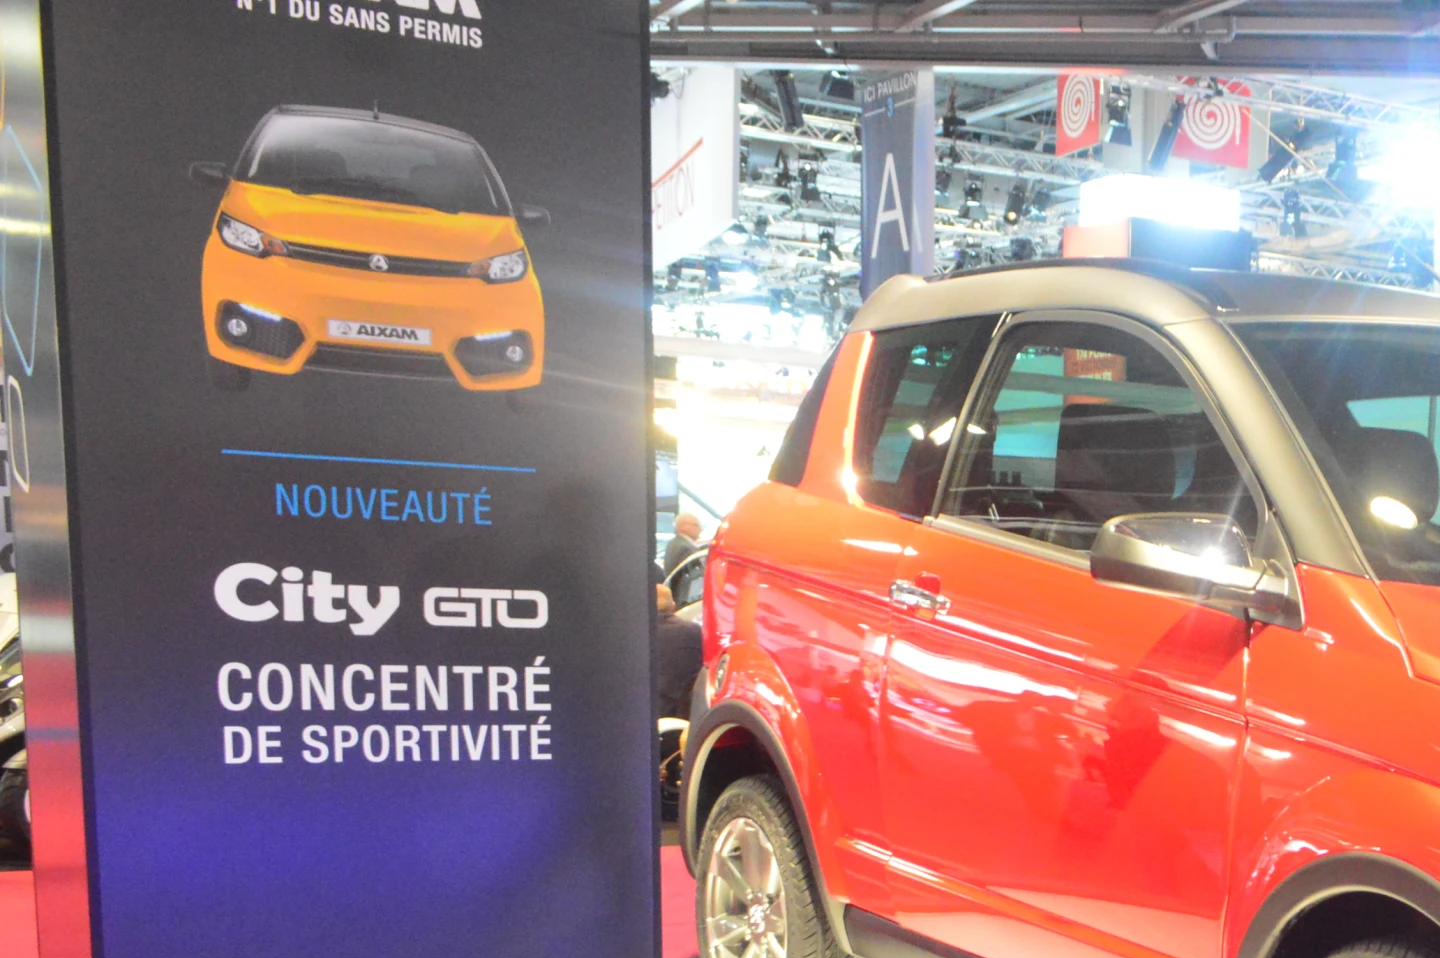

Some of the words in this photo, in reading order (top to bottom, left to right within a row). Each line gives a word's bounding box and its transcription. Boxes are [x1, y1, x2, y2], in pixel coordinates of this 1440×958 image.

[289, 0, 321, 21] DU
[329, 4, 391, 33] SANS
[399, 15, 483, 48] PERMIS
[877, 72, 917, 97] PAVILLON
[887, 97, 894, 118] 3
[871, 153, 909, 259] A
[356, 325, 418, 341] AIXAM
[275, 483, 492, 526] NOUVEAUTÉ
[214, 562, 400, 636] City
[423, 586, 549, 629] GTO
[217, 656, 552, 712] CONCENTRÉ
[223, 725, 283, 764] DE
[302, 716, 553, 763] SPORTIVITÉ
